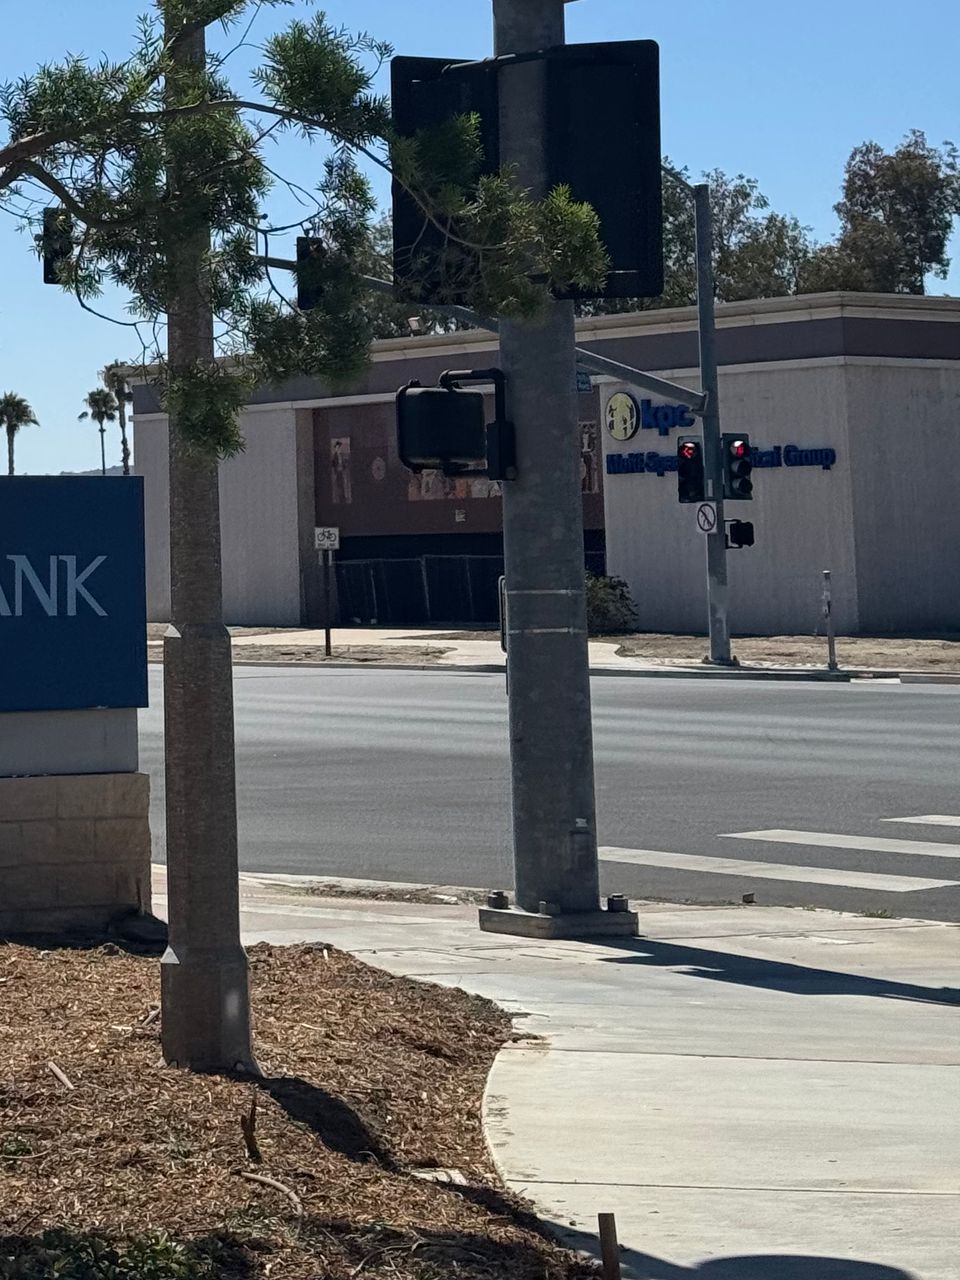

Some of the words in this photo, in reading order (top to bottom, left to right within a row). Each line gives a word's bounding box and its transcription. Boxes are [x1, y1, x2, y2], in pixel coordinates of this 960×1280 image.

[641, 399, 695, 436] kpc
[606, 453, 645, 474] Multi
[783, 445, 836, 470] Group
